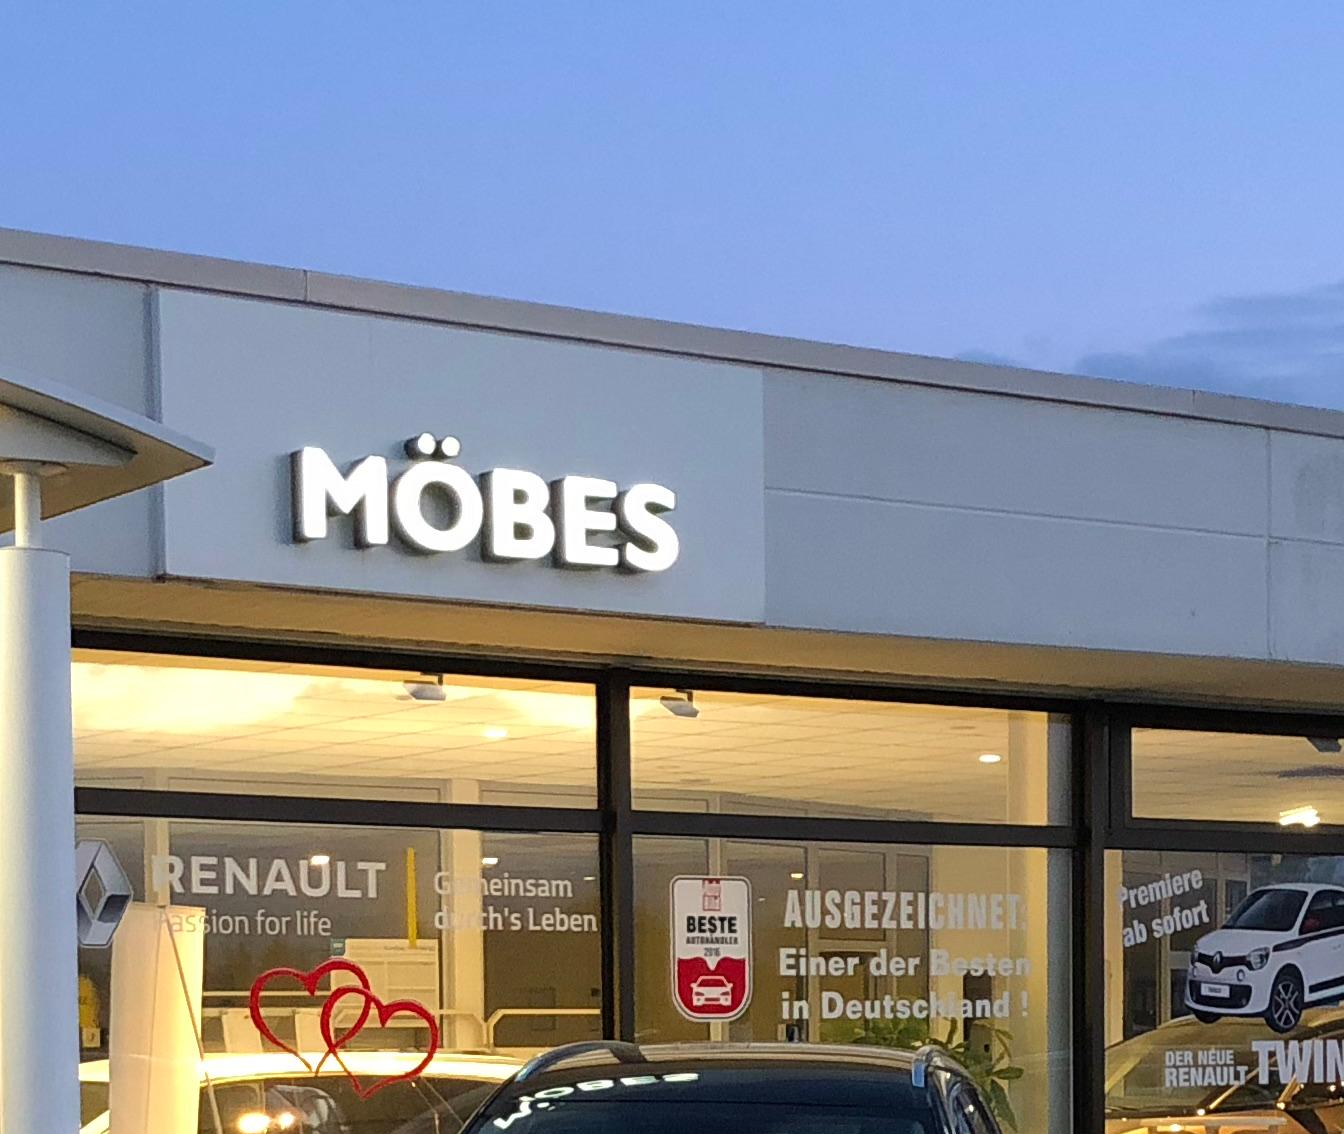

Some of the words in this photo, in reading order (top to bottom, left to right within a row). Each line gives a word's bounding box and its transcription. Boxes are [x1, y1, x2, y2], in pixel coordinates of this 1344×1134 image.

[296, 432, 680, 572] MÖBES
[152, 855, 386, 898] RENAULT
[434, 871, 574, 898] Geinsam
[1118, 869, 1204, 909] Premiere
[160, 905, 251, 935] assion
[256, 909, 290, 935] for
[296, 909, 333, 936] life
[434, 905, 522, 931] dch's
[527, 907, 598, 932] Leben
[686, 916, 738, 933] BESTE
[1122, 920, 1148, 948] ab
[1151, 899, 1210, 939] sofort
[686, 935, 738, 945] AUTOHÄNDLER
[779, 948, 860, 976] Einer
[869, 949, 920, 976] der
[930, 950, 1031, 977] Besten
[781, 992, 810, 1019] in
[821, 991, 1011, 1020] Deutschland
[1165, 1050, 1194, 1066] DER
[1198, 1049, 1234, 1065] NEUE
[1165, 1065, 1249, 1088] RENAULT
